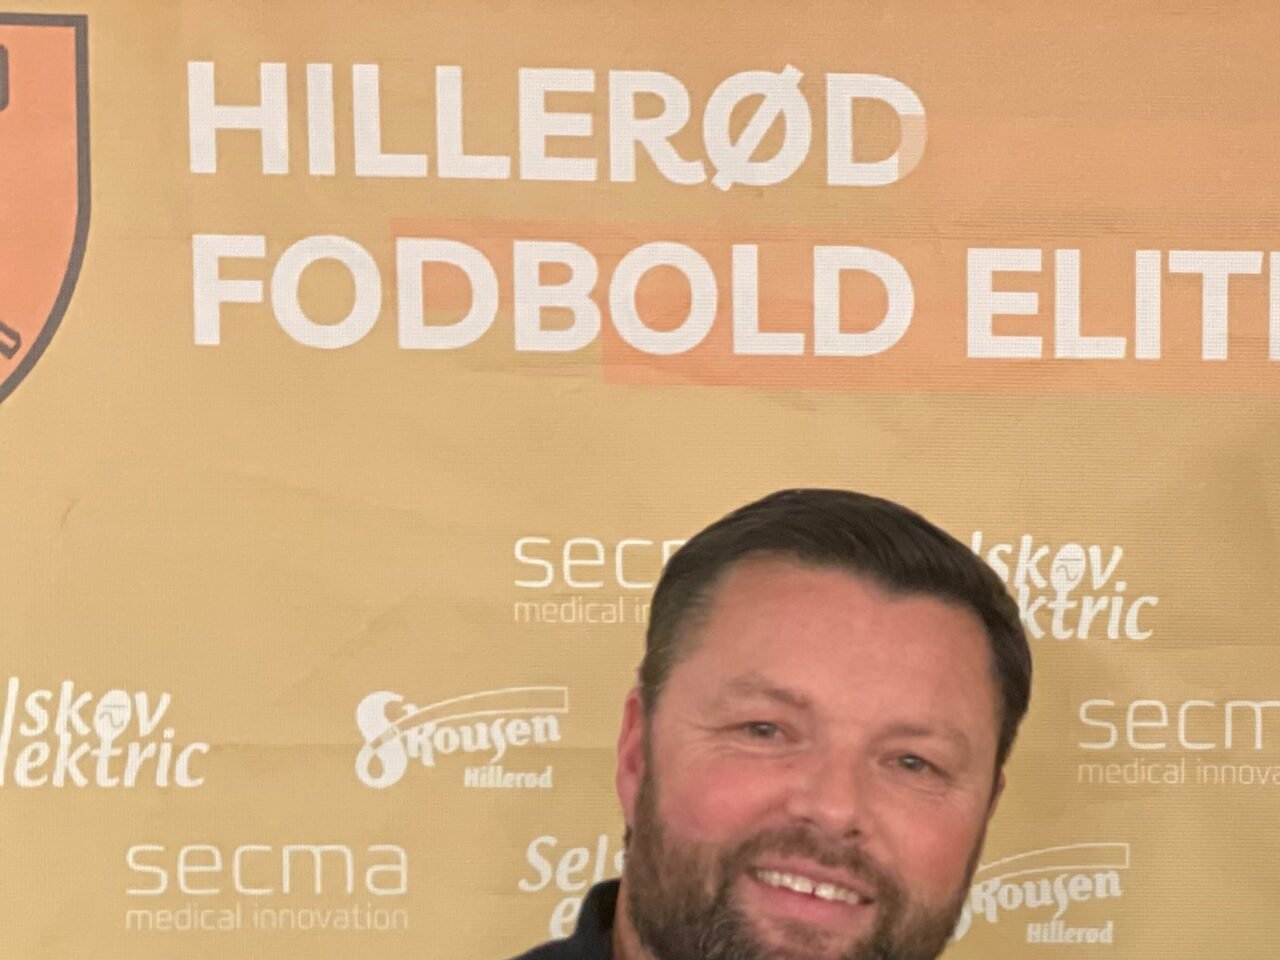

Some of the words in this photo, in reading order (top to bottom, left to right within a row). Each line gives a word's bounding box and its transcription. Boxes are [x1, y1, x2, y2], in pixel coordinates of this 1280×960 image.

[187, 61, 928, 191] HILLERØD
[192, 234, 914, 356] FODBOLD
[513, 536, 688, 589] sec
[513, 595, 625, 624] medical
[1018, 580, 1160, 640] ktric
[1077, 756, 1186, 785] medical
[125, 844, 408, 896] secma
[125, 903, 242, 931] medical
[253, 902, 410, 931] innovation
[954, 869, 1123, 942] kousen
